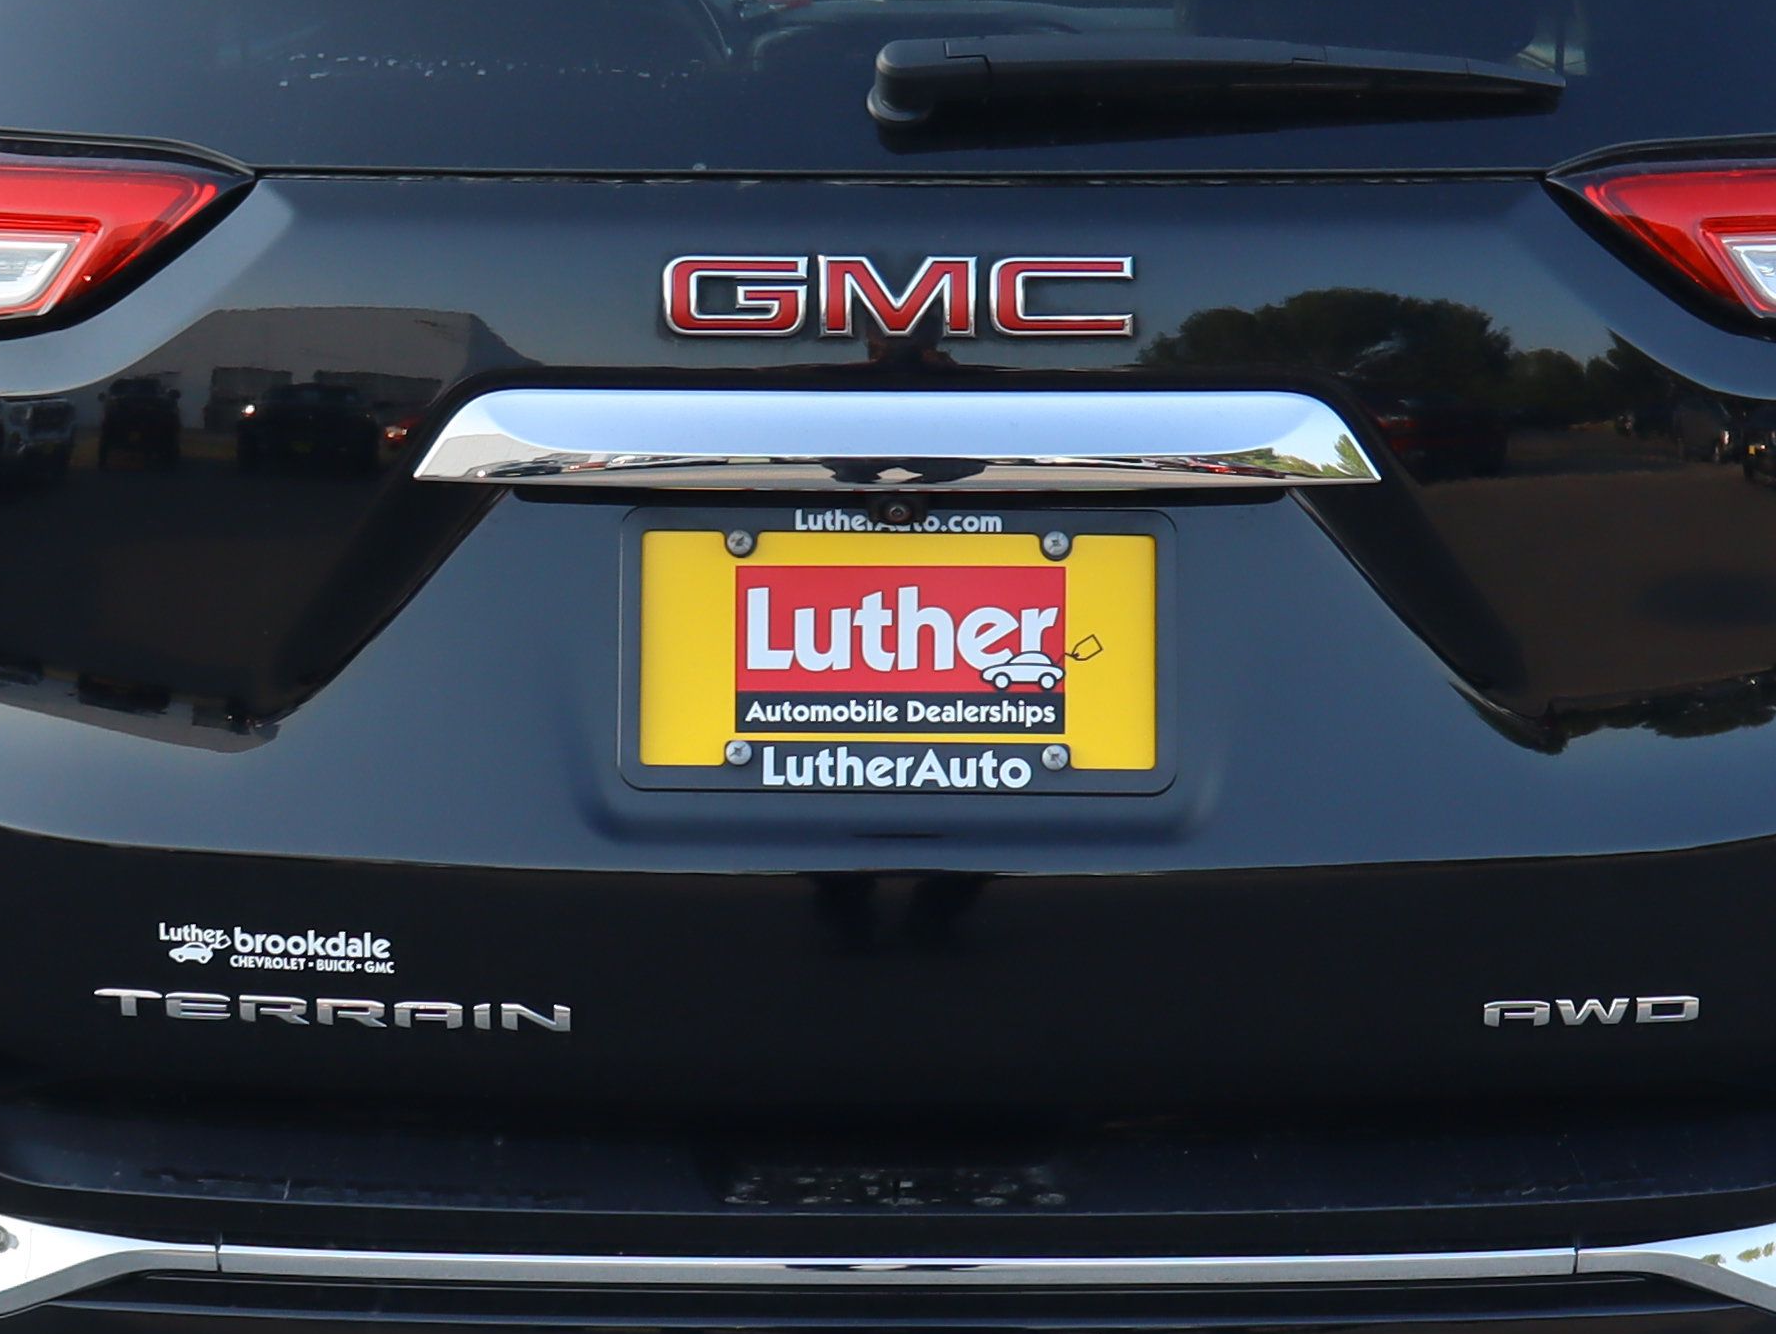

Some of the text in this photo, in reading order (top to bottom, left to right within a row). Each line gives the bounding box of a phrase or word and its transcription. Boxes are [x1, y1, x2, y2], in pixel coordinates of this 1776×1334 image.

[662, 255, 1134, 338] GMC
[746, 585, 1059, 672] Luther
[744, 700, 1057, 727] Automobile Dealerships
[761, 745, 1032, 789] LutherAuto
[158, 922, 392, 959] Luther brookdale
[229, 954, 396, 975] CHEVROLET BUICK GMC
[94, 987, 572, 1032] TERRAIN
[1483, 994, 1700, 1028] AWD
